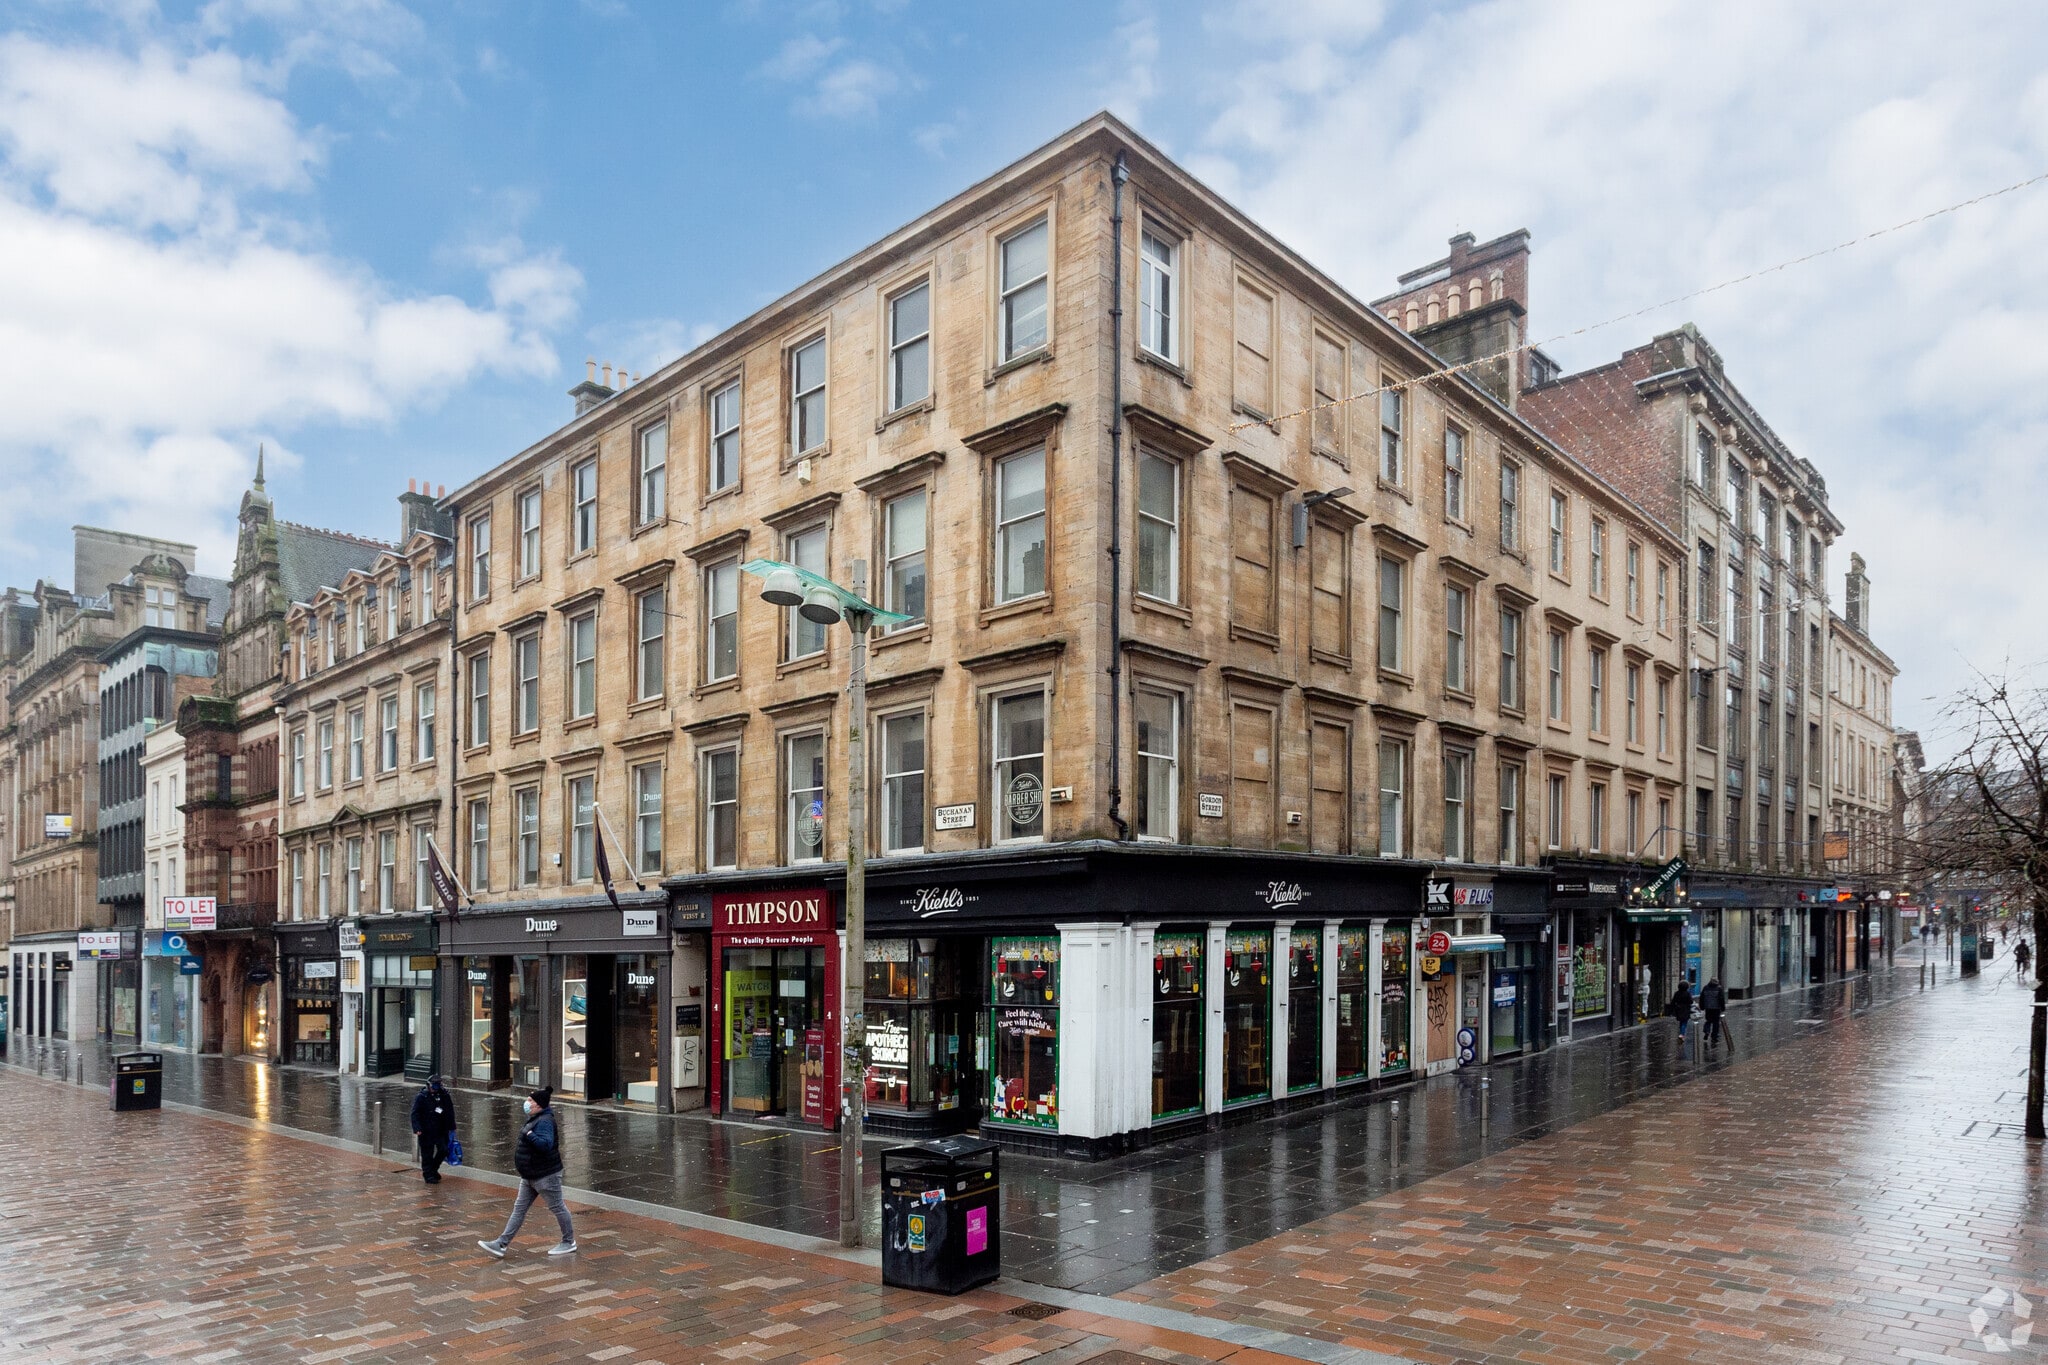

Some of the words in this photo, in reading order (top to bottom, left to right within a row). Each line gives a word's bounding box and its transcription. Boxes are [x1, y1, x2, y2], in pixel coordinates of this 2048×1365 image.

[1201, 795, 1222, 804] GORDON
[937, 806, 973, 817] BUCHANAN
[1201, 803, 1222, 812] STREET
[942, 815, 968, 824] STREET
[434, 870, 454, 902] Dune
[1265, 881, 1302, 904] Kiehl's
[1468, 888, 1494, 905] PLUS
[912, 887, 964, 912] Kiehl's
[166, 901, 186, 914] TO
[190, 900, 215, 914] LET
[724, 899, 820, 925] TIMPSON
[525, 917, 558, 932] Dune
[626, 918, 655, 926] Dune
[80, 936, 95, 944] TO
[98, 935, 120, 944] LET
[743, 936, 765, 945] Quality
[765, 936, 790, 944] Service
[791, 935, 814, 944] People
[1432, 939, 1446, 949] 24
[467, 970, 487, 980] Dune
[628, 973, 655, 985] Dune
[736, 982, 770, 992] WATCH
[1005, 1009, 1019, 1018] Feel
[1019, 1009, 1030, 1017] the
[998, 1020, 1014, 1028] Care
[1014, 1018, 1028, 1026] with
